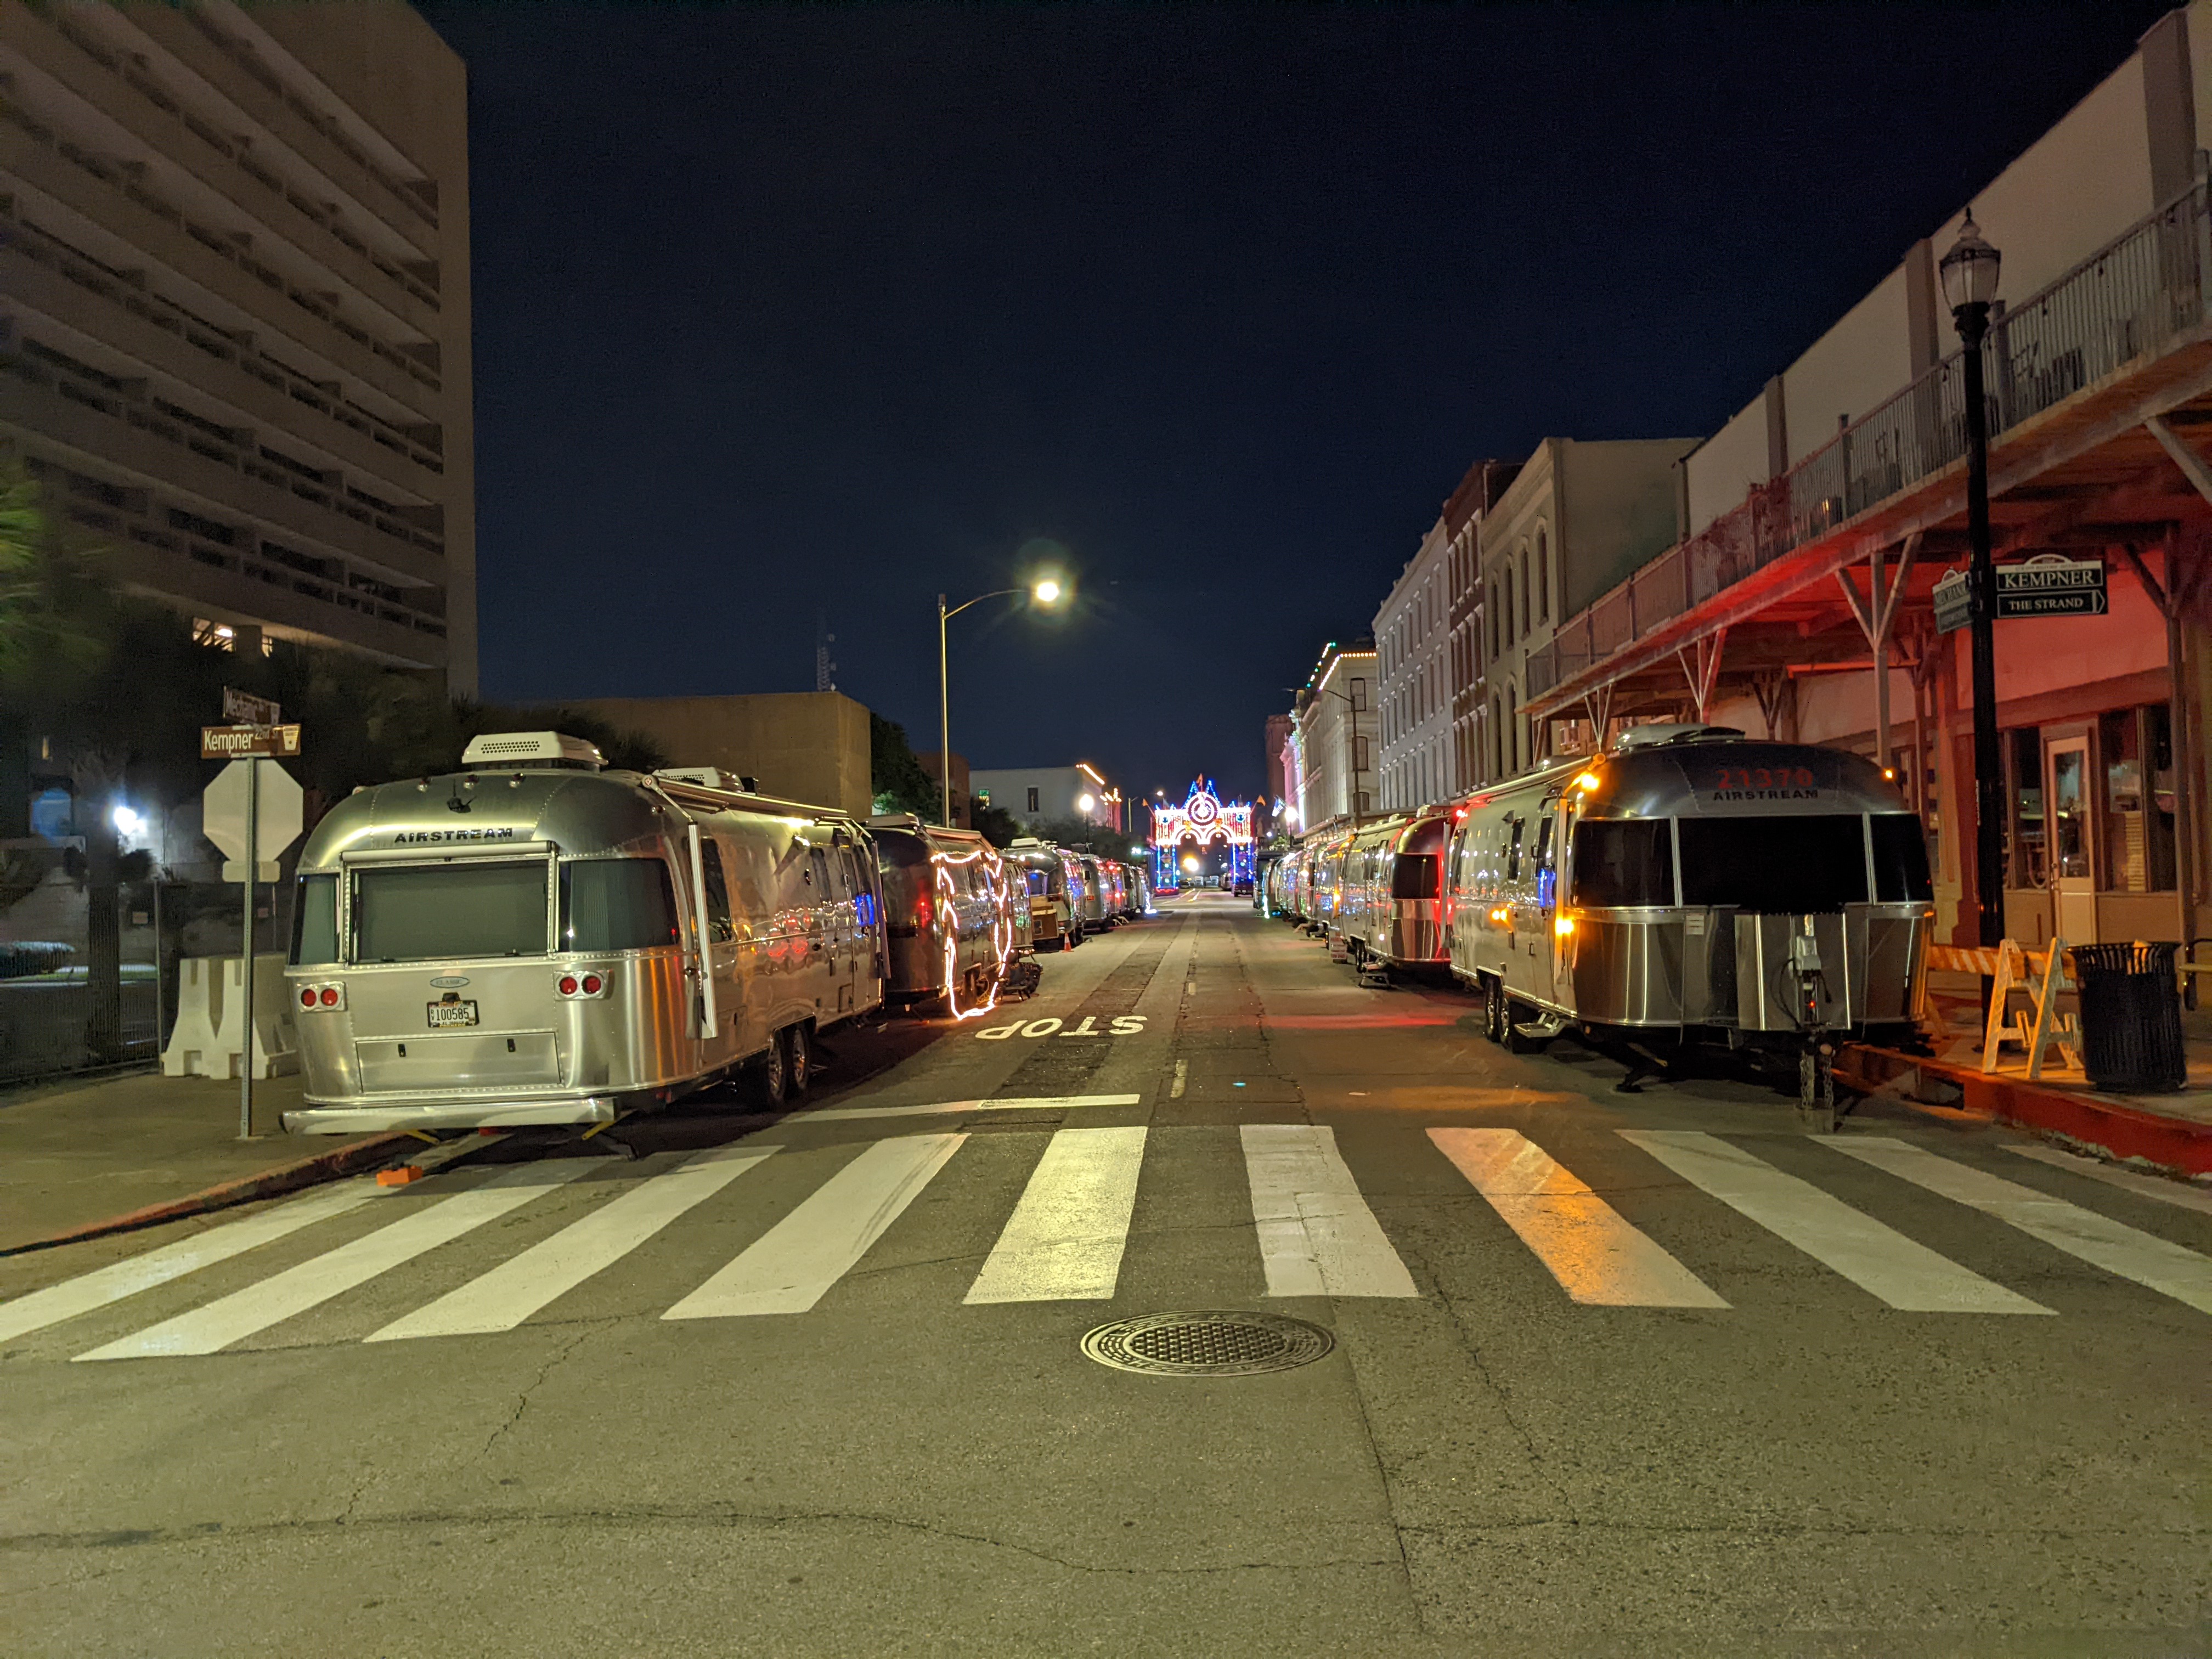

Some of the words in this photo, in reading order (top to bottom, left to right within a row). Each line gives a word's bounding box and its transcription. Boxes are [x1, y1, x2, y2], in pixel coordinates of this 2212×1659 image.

[2005, 569, 2095, 589] KEMPNER
[2009, 600, 2032, 611] THE
[2034, 596, 2084, 610] STRAND
[204, 730, 253, 755] Kempner
[1716, 769, 1814, 789] 21370
[1713, 789, 1819, 801] AIRSTREAM
[394, 827, 513, 843] AIRSTREAM
[436, 1007, 470, 1021] 100585
[975, 1015, 1148, 1040] STOP
